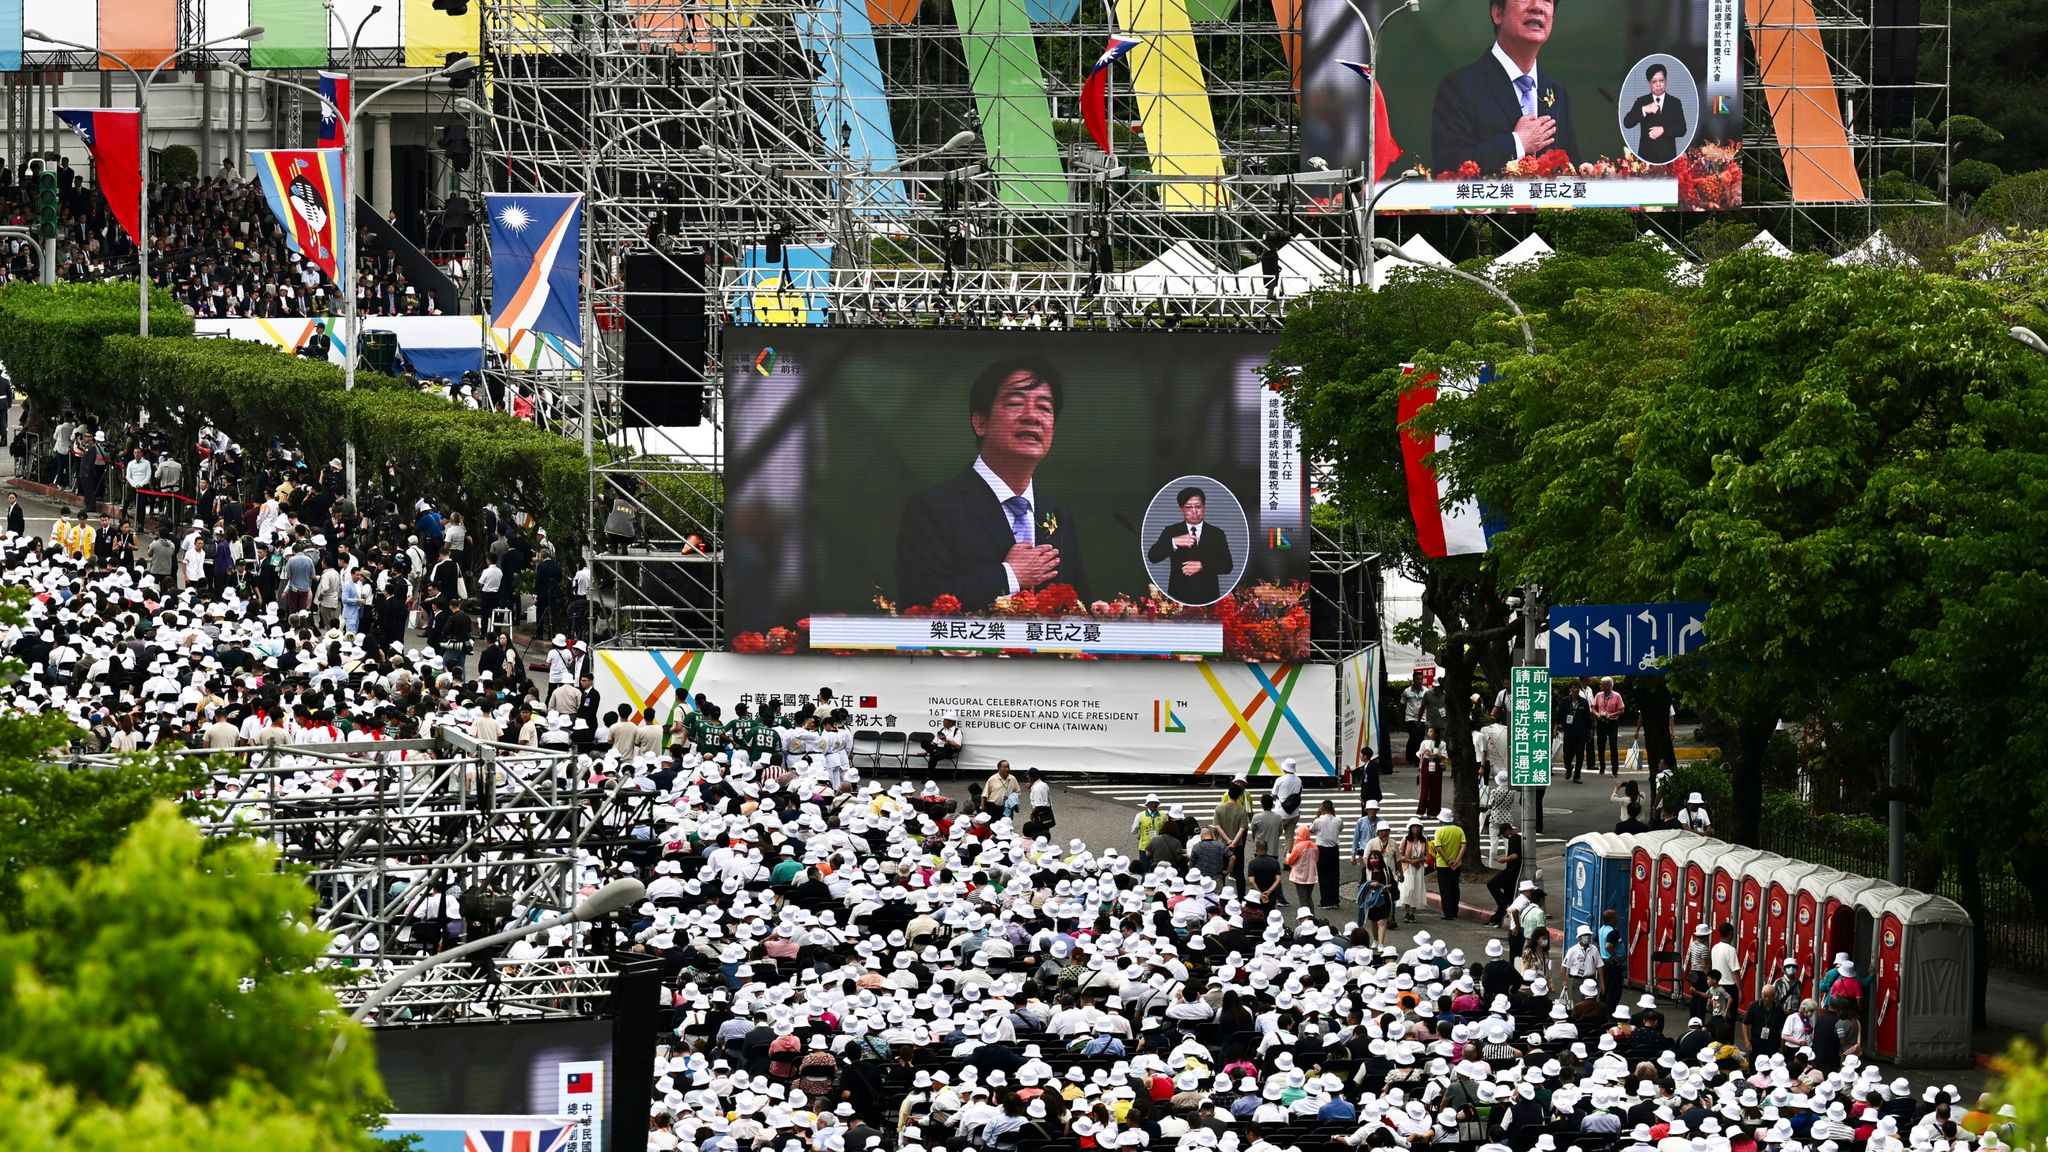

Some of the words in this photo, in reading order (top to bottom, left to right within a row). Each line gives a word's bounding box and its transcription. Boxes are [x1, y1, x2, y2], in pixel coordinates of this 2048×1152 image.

[1456, 183, 1514, 199] 樂民之樂
[1529, 182, 1587, 199] 憂民之憂
[1268, 398, 1279, 511] 總統副總統就職慶祝大會
[1282, 412, 1293, 481] 民國第十六任
[930, 621, 1006, 640] 樂民之樂
[1026, 622, 1101, 642] 憂民之憂
[928, 697, 983, 706] INAUGURAL
[986, 698, 1058, 707] CELEBRATIONS
[1060, 699, 1080, 708] FOR
[1082, 700, 1100, 708] THE
[929, 708, 952, 717] 16T
[955, 709, 981, 717] TERM
[983, 709, 1036, 718] PRESIDENT
[1038, 710, 1059, 719] AND
[1062, 711, 1083, 719] VICE
[1086, 712, 1139, 720] PRESIDENT
[928, 719, 941, 728] OF
[965, 720, 1011, 729] REPUBLIC
[1013, 721, 1027, 729] OF
[1029, 722, 1060, 730] CHINA
[1062, 722, 1108, 732] (TAIWAN)
[1515, 669, 1531, 784] 請由鄰近路口通行
[1532, 669, 1548, 784] 前方無行穿線
[705, 734, 720, 746] 30
[756, 734, 773, 748] 99
[567, 1103, 578, 1152] 總副總
